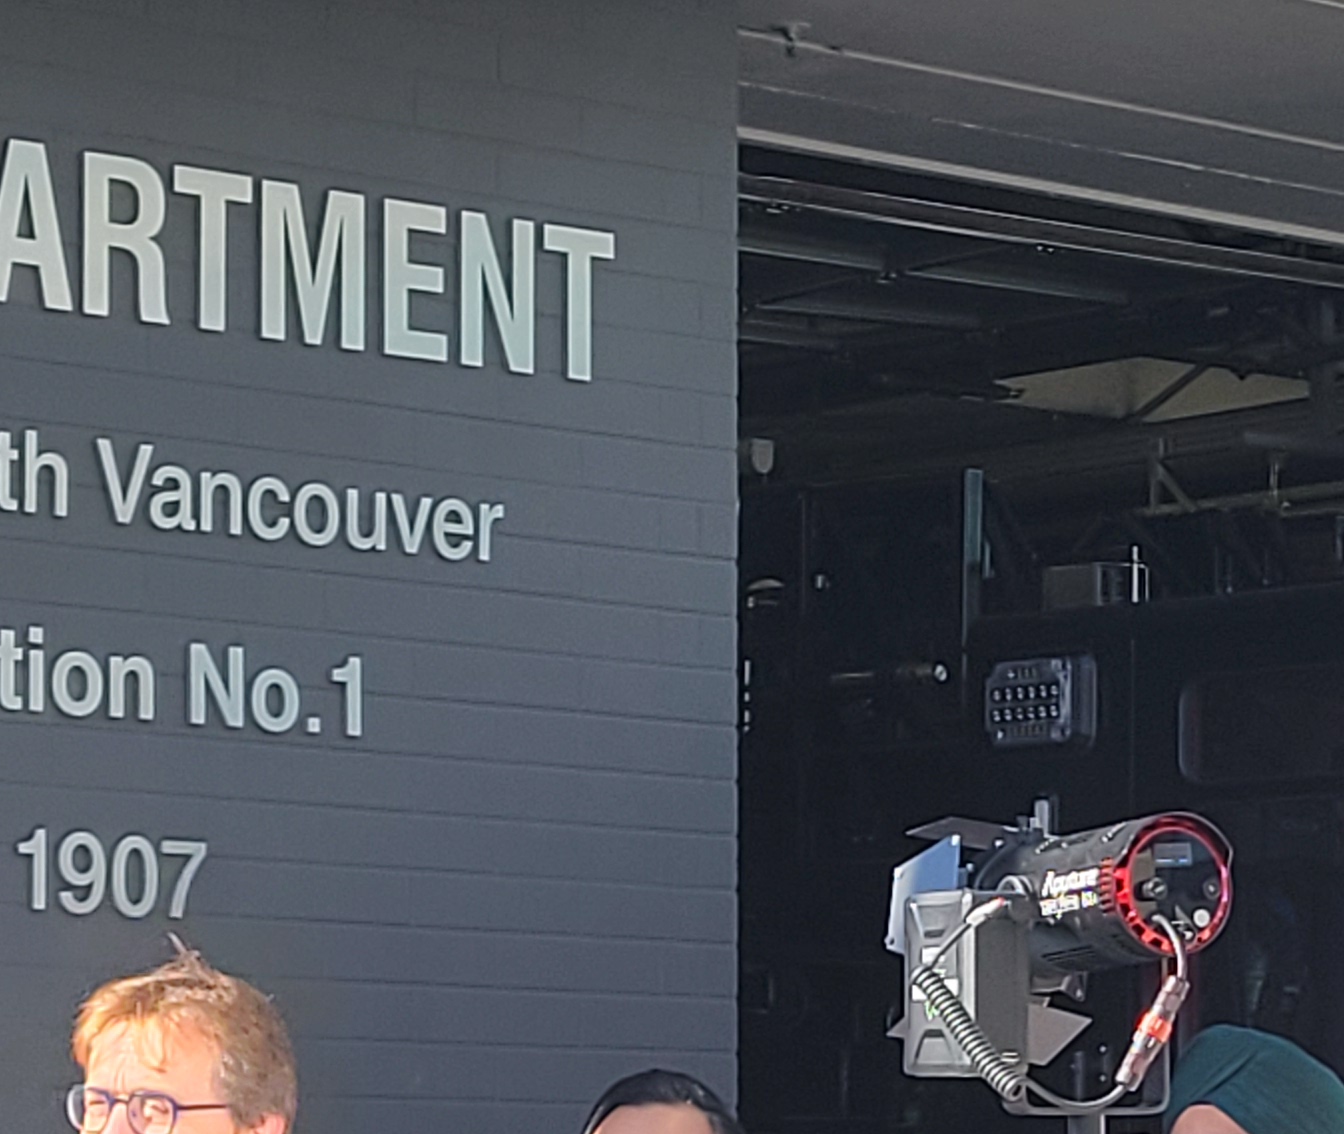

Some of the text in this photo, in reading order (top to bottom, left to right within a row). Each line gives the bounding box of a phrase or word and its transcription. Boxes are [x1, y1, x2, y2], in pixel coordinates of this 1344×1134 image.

[96, 437, 504, 563] Vancouver
[187, 641, 364, 737] No.1
[16, 826, 209, 919] 1907
